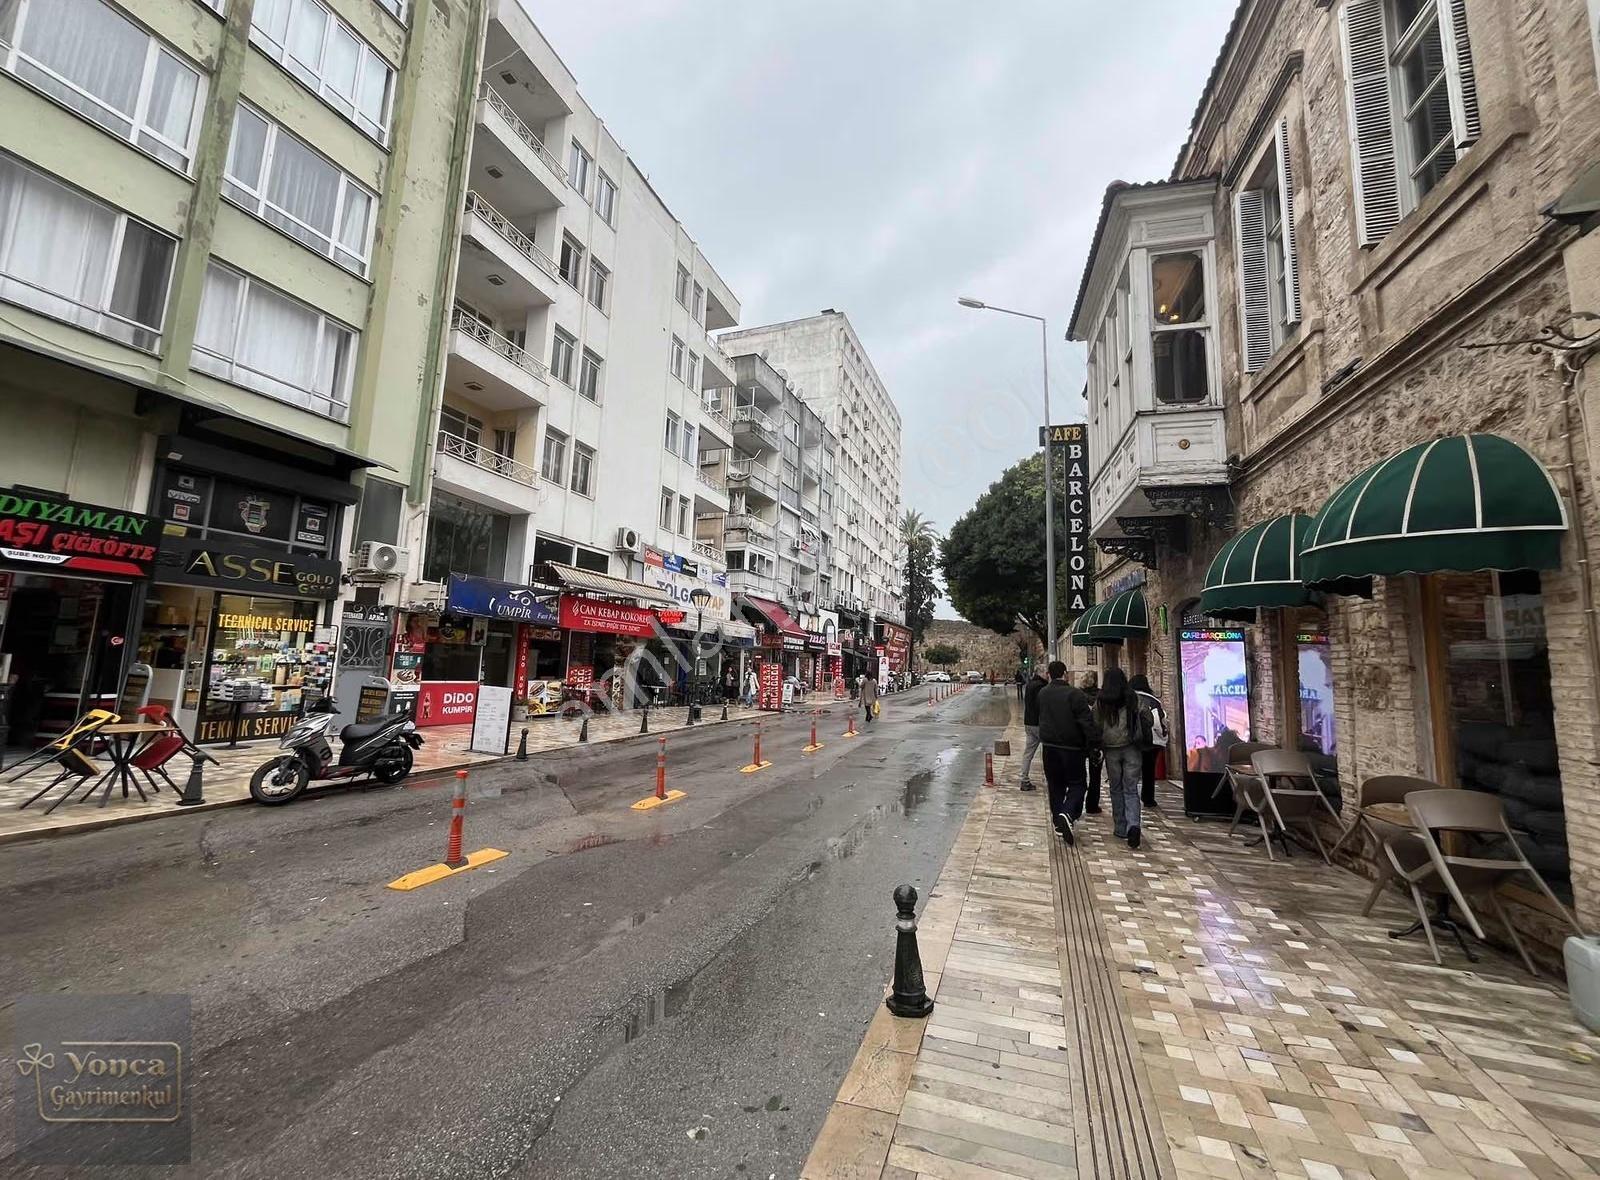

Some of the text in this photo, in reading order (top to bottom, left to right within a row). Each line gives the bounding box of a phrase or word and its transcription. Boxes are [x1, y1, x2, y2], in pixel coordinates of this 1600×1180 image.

[1048, 426, 1082, 441] AFE
[0, 494, 149, 536] DIYAMAN
[1069, 444, 1086, 609] BARCELONA
[0, 519, 49, 548] AŞI
[52, 530, 156, 561] ÇİĞKÖFTE
[7, 550, 30, 558] ŞUBE
[184, 551, 296, 586] ASSE
[296, 572, 334, 586] GOLD
[656, 580, 693, 604] TOLG
[580, 604, 597, 616] CAN
[598, 607, 620, 619] KEBAP
[218, 613, 315, 632] TECHNICAL SERVICE
[1181, 631, 1243, 640] CAFE BARCELONA
[443, 692, 475, 705] DİDO
[442, 705, 473, 715] KUMPİR
